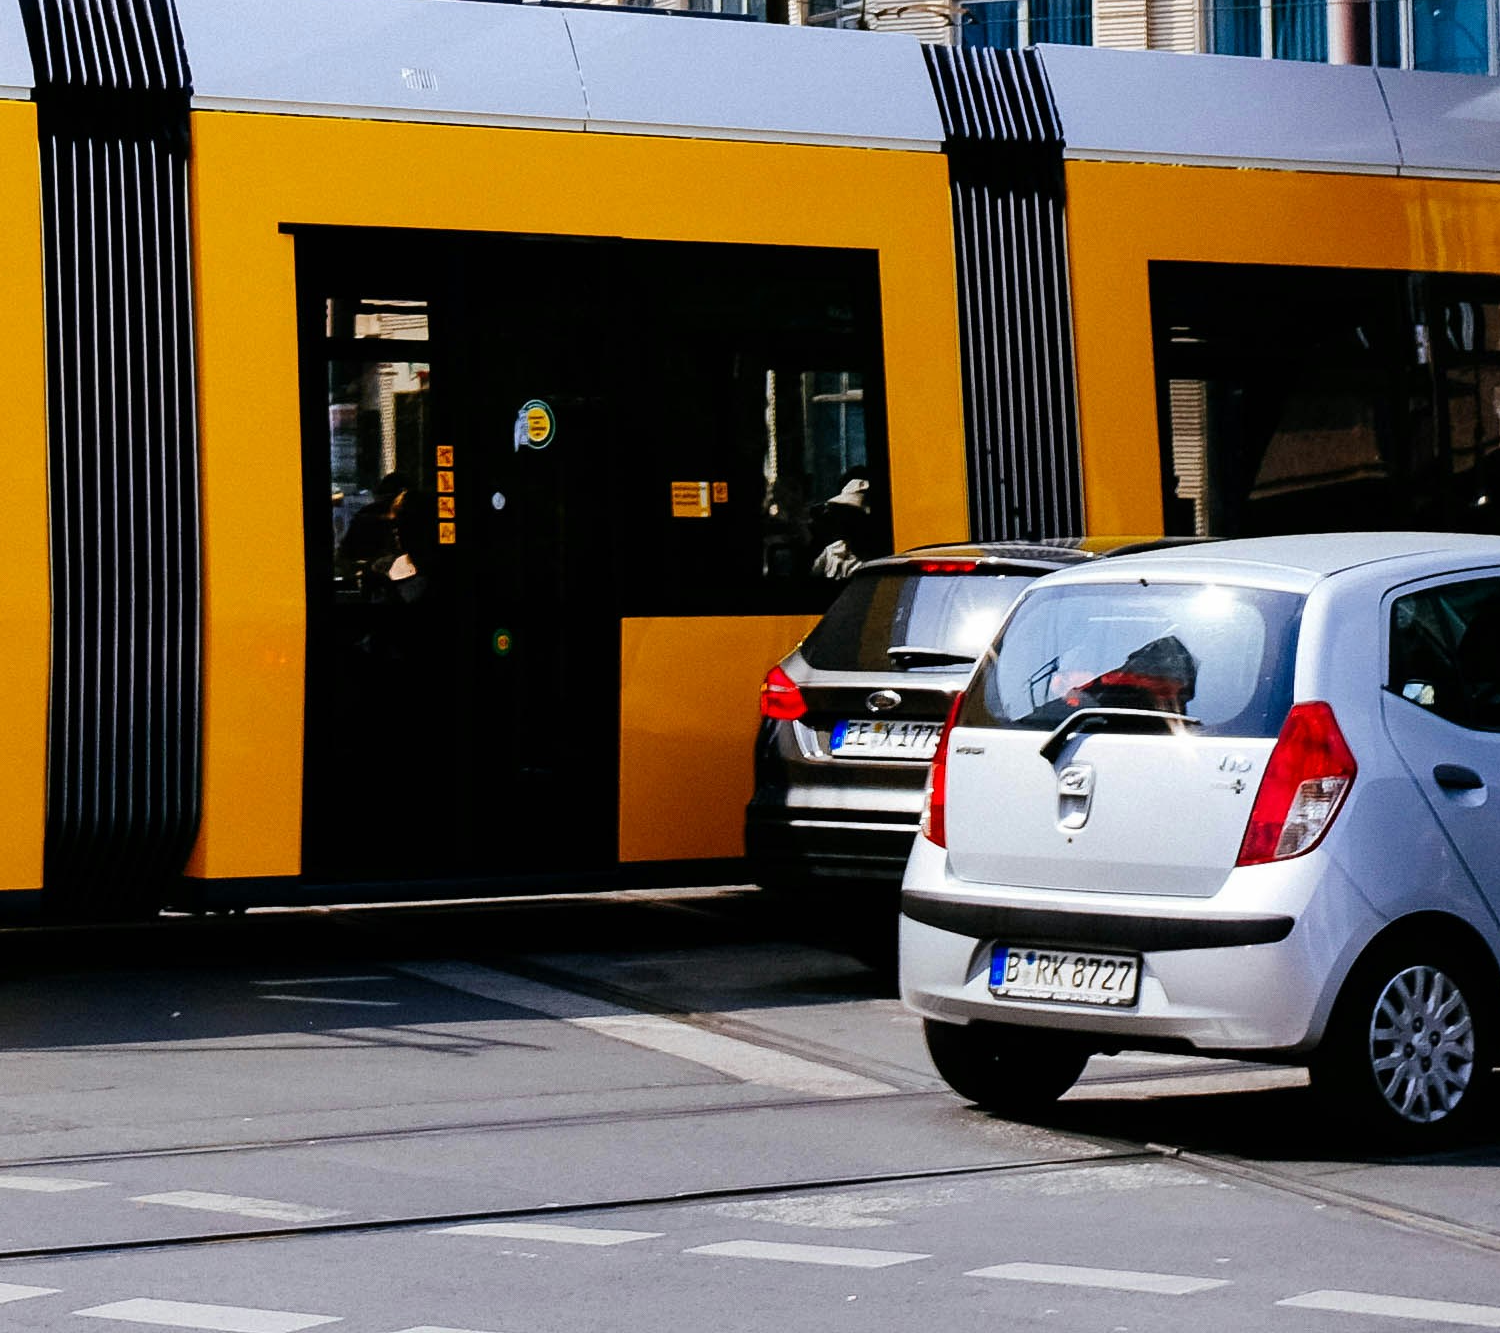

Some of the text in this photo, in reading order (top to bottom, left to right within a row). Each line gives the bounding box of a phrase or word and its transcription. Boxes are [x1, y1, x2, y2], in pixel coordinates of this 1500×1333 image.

[1006, 952, 1134, 992] B RK 8727
